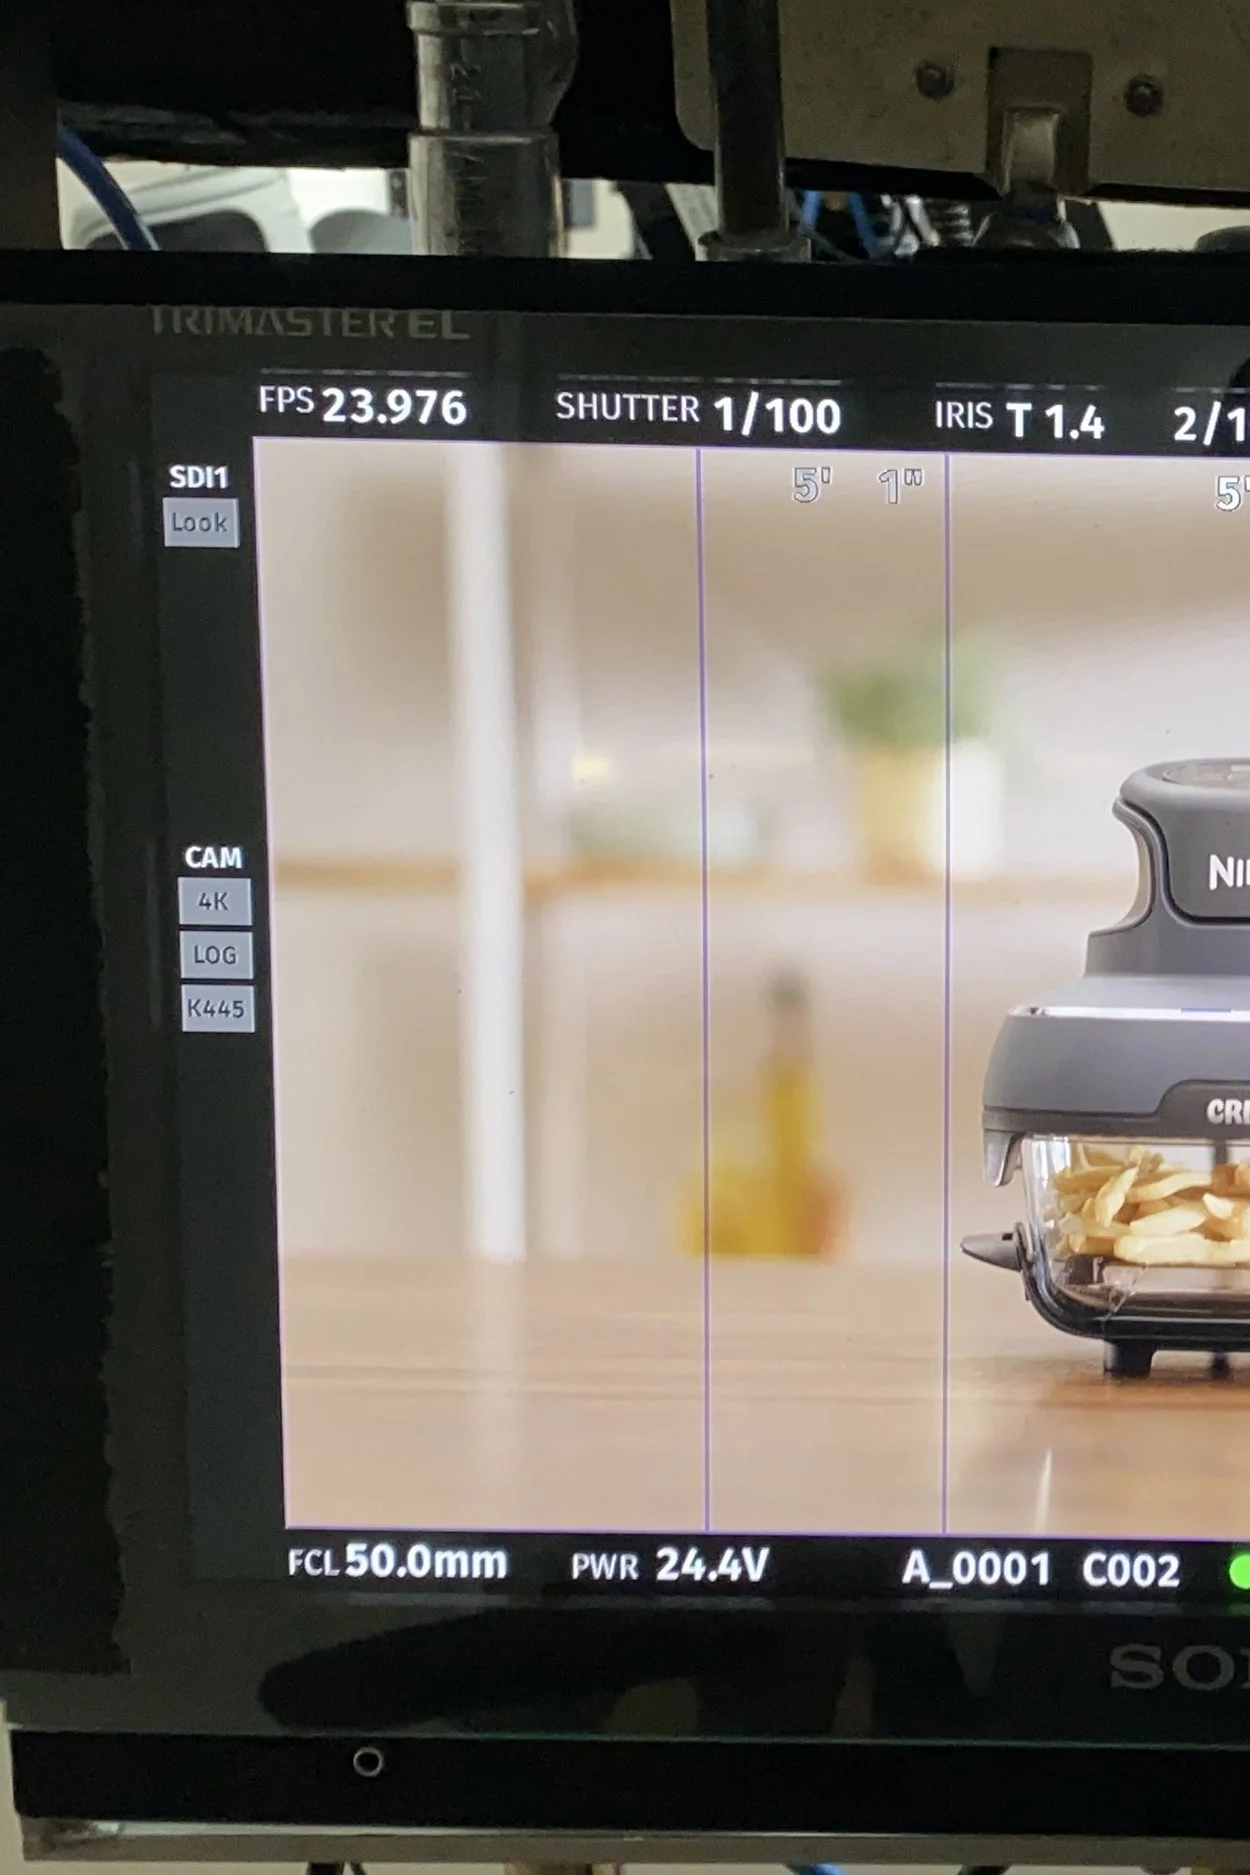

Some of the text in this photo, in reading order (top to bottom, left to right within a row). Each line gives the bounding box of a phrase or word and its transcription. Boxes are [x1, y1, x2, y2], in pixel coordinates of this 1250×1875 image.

[150, 306, 471, 341] TRIMASTER EL
[259, 385, 467, 426] FPS 23.976
[556, 390, 842, 437] SHUTTER 1/100
[935, 400, 1106, 440] IRIS T 1.4
[169, 464, 228, 489] SDI1
[172, 511, 227, 533] Look
[184, 845, 243, 869] CAM
[198, 891, 228, 911] 4K
[194, 945, 236, 965] LOG
[187, 998, 245, 1019] K445
[288, 1542, 508, 1579] FCL 50.0mm
[572, 1546, 770, 1582] PWR 24.4V
[901, 1548, 1180, 1590] A_0001 C002
